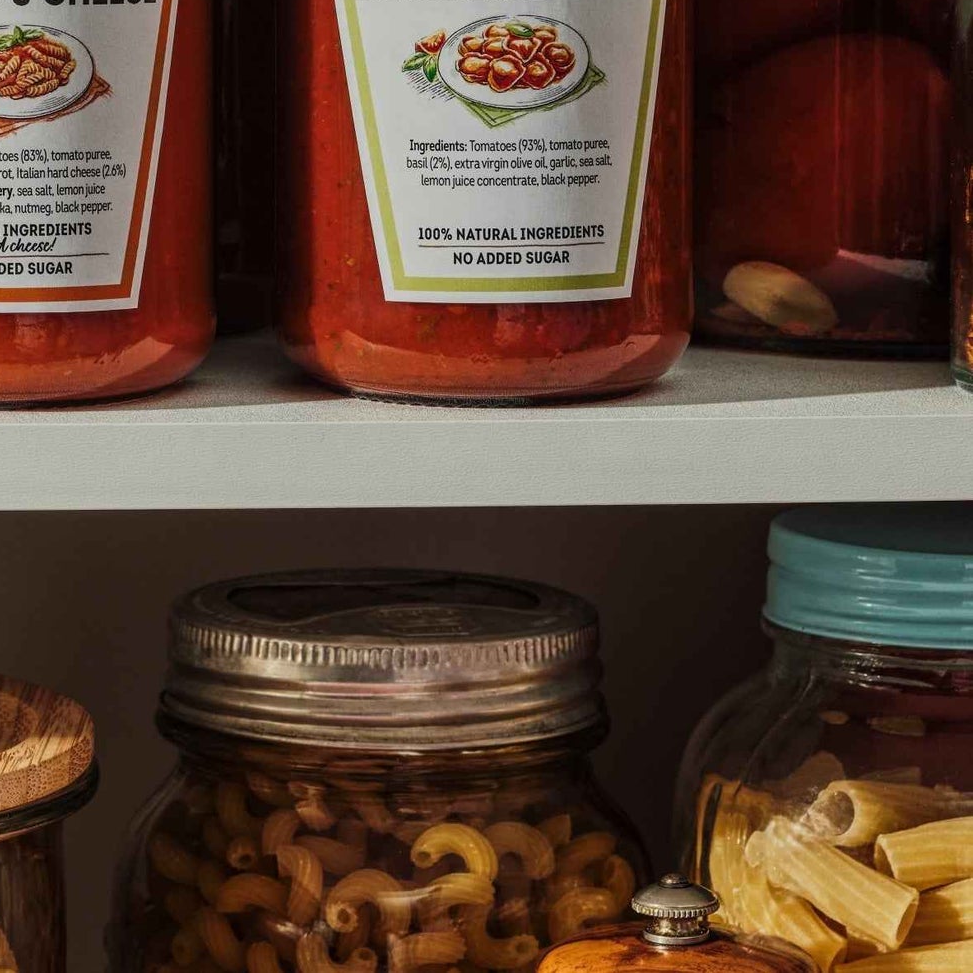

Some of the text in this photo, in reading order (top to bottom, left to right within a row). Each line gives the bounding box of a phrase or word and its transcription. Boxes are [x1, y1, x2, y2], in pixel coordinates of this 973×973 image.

[409, 139, 610, 154] Ingredients: Tomatoes (93%), tomato puree,
[20, 149, 49, 164] (83%),
[51, 150, 84, 161] tomato
[406, 154, 613, 171] basil (2%), extra virgin olive oil, garlic, sea salt,
[16, 167, 46, 179] Italian
[47, 167, 69, 178] hard
[70, 166, 101, 177] cheese
[101, 165, 127, 178] (2.6%)
[421, 174, 601, 189] lemon juice concentrate, black pepper.
[17, 186, 33, 196] sea
[34, 184, 55, 197] salt,
[56, 184, 85, 195] lemon
[85, 184, 106, 198] juice
[14, 203, 54, 216] nutmeg,
[55, 201, 79, 213] black
[81, 202, 113, 215] pepper.
[3, 222, 92, 237] INGREDIENTS
[418, 225, 605, 241] 100% NATURAL INGREDIENTS
[10, 237, 57, 253] cheese!
[453, 251, 570, 265] NO ADDED SUGAR
[27, 261, 73, 275] SUGAR
